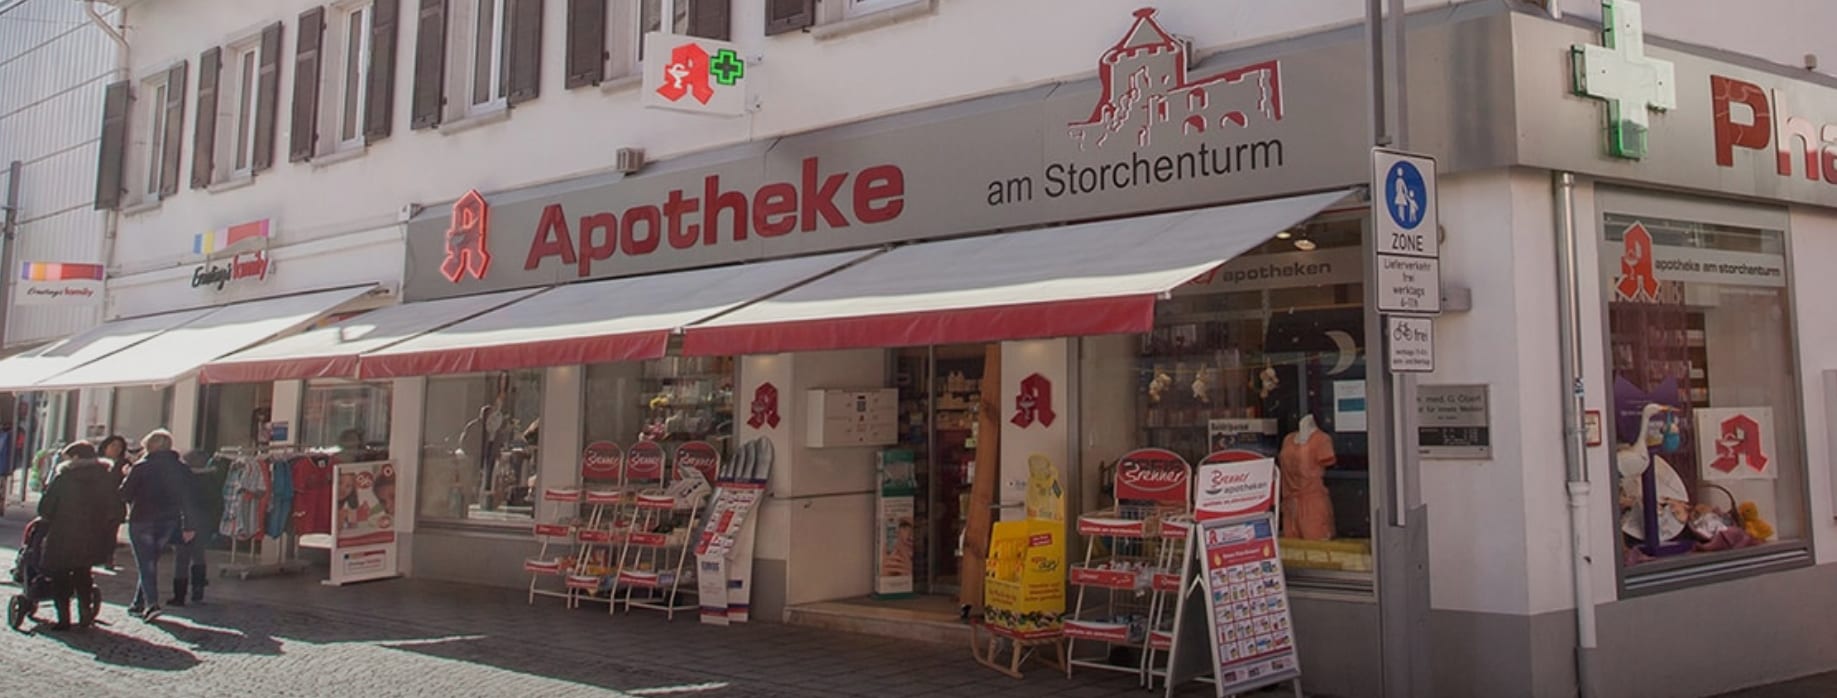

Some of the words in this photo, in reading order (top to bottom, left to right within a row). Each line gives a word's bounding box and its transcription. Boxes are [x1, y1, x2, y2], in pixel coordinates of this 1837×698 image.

[986, 176, 1032, 207] am
[1044, 138, 1284, 198] Storchenturm
[524, 156, 904, 276] Apotheke
[1392, 233, 1424, 252] ZONE
[1222, 262, 1332, 284] apotheken
[1384, 259, 1432, 271] Lieferverkehr
[1655, 258, 1700, 272] apotheke
[1703, 262, 1718, 272] am
[1719, 263, 1780, 277] storchenturm
[1403, 271, 1414, 282] frei
[1393, 286, 1425, 298] werktags
[1414, 328, 1429, 342] frei
[1124, 462, 1184, 482] Brenner
[1210, 470, 1250, 488] Brenner
[1223, 481, 1268, 494] apotheken
